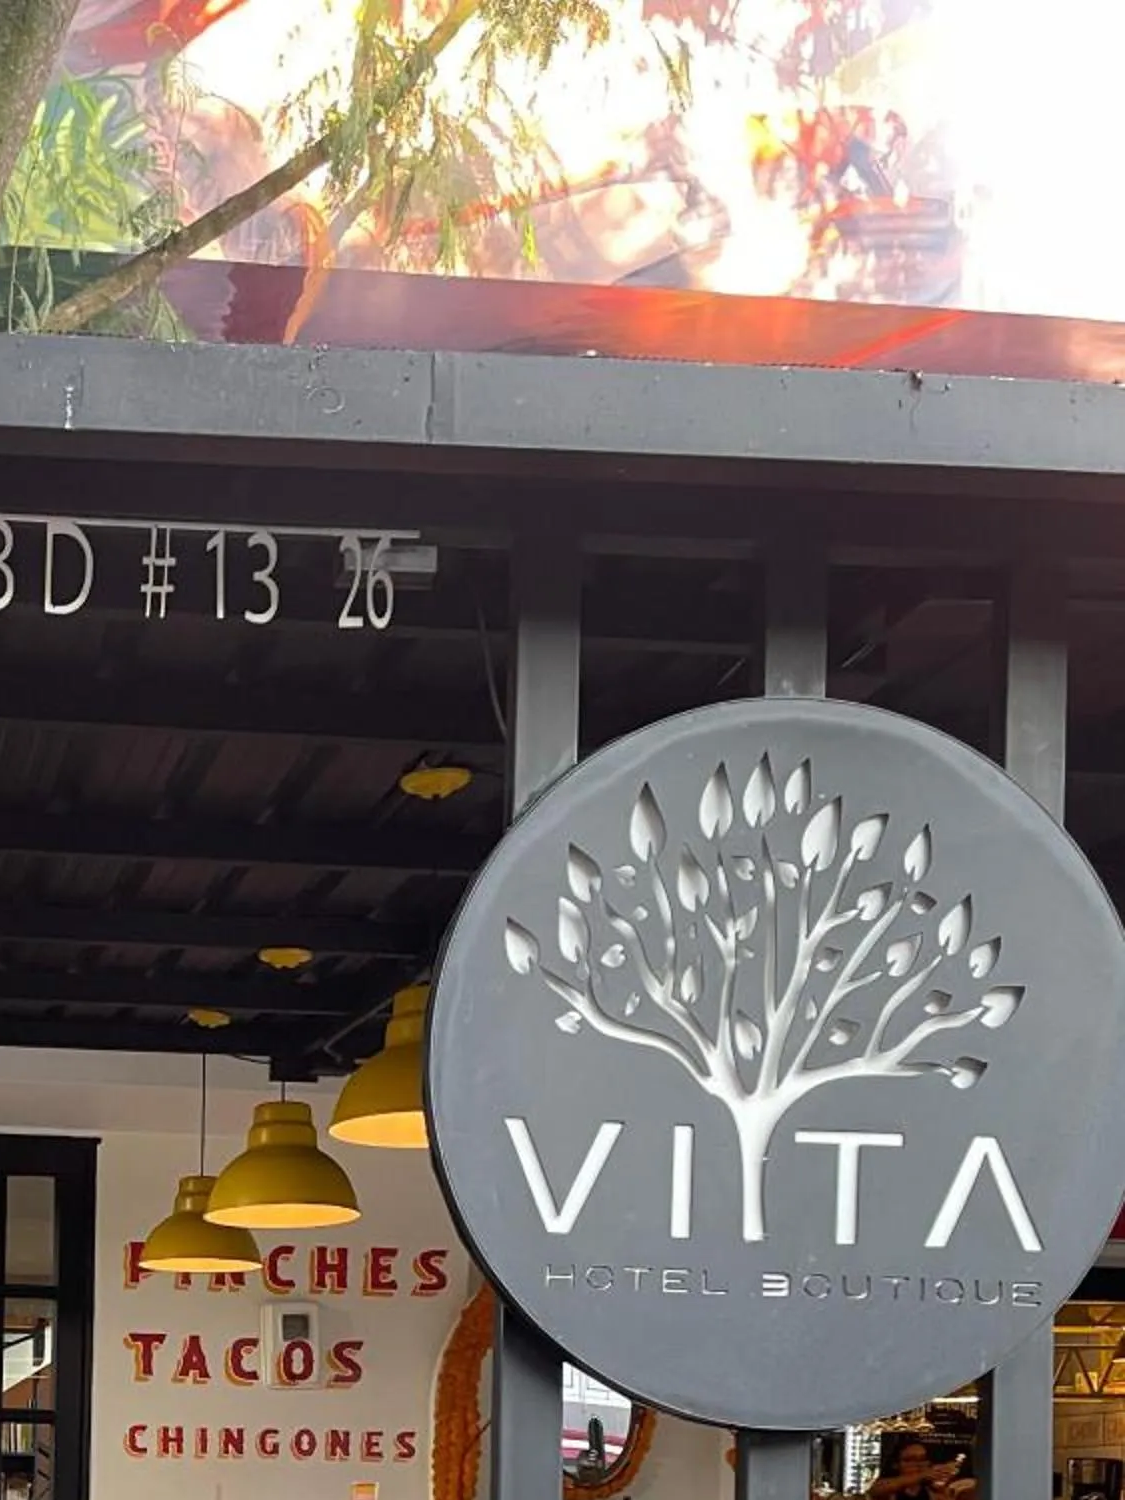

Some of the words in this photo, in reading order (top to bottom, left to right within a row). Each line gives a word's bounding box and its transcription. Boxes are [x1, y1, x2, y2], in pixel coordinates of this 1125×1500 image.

[140, 523, 279, 625] #13
[337, 534, 395, 629] 26
[504, 1116, 1046, 1254] VITA
[123, 1240, 450, 1297] PCHES
[544, 1263, 730, 1297] HOTEL
[761, 1270, 1045, 1308] BOUTIQUE
[123, 1331, 365, 1389] TACOS
[123, 1422, 418, 1463] CHINGONES
